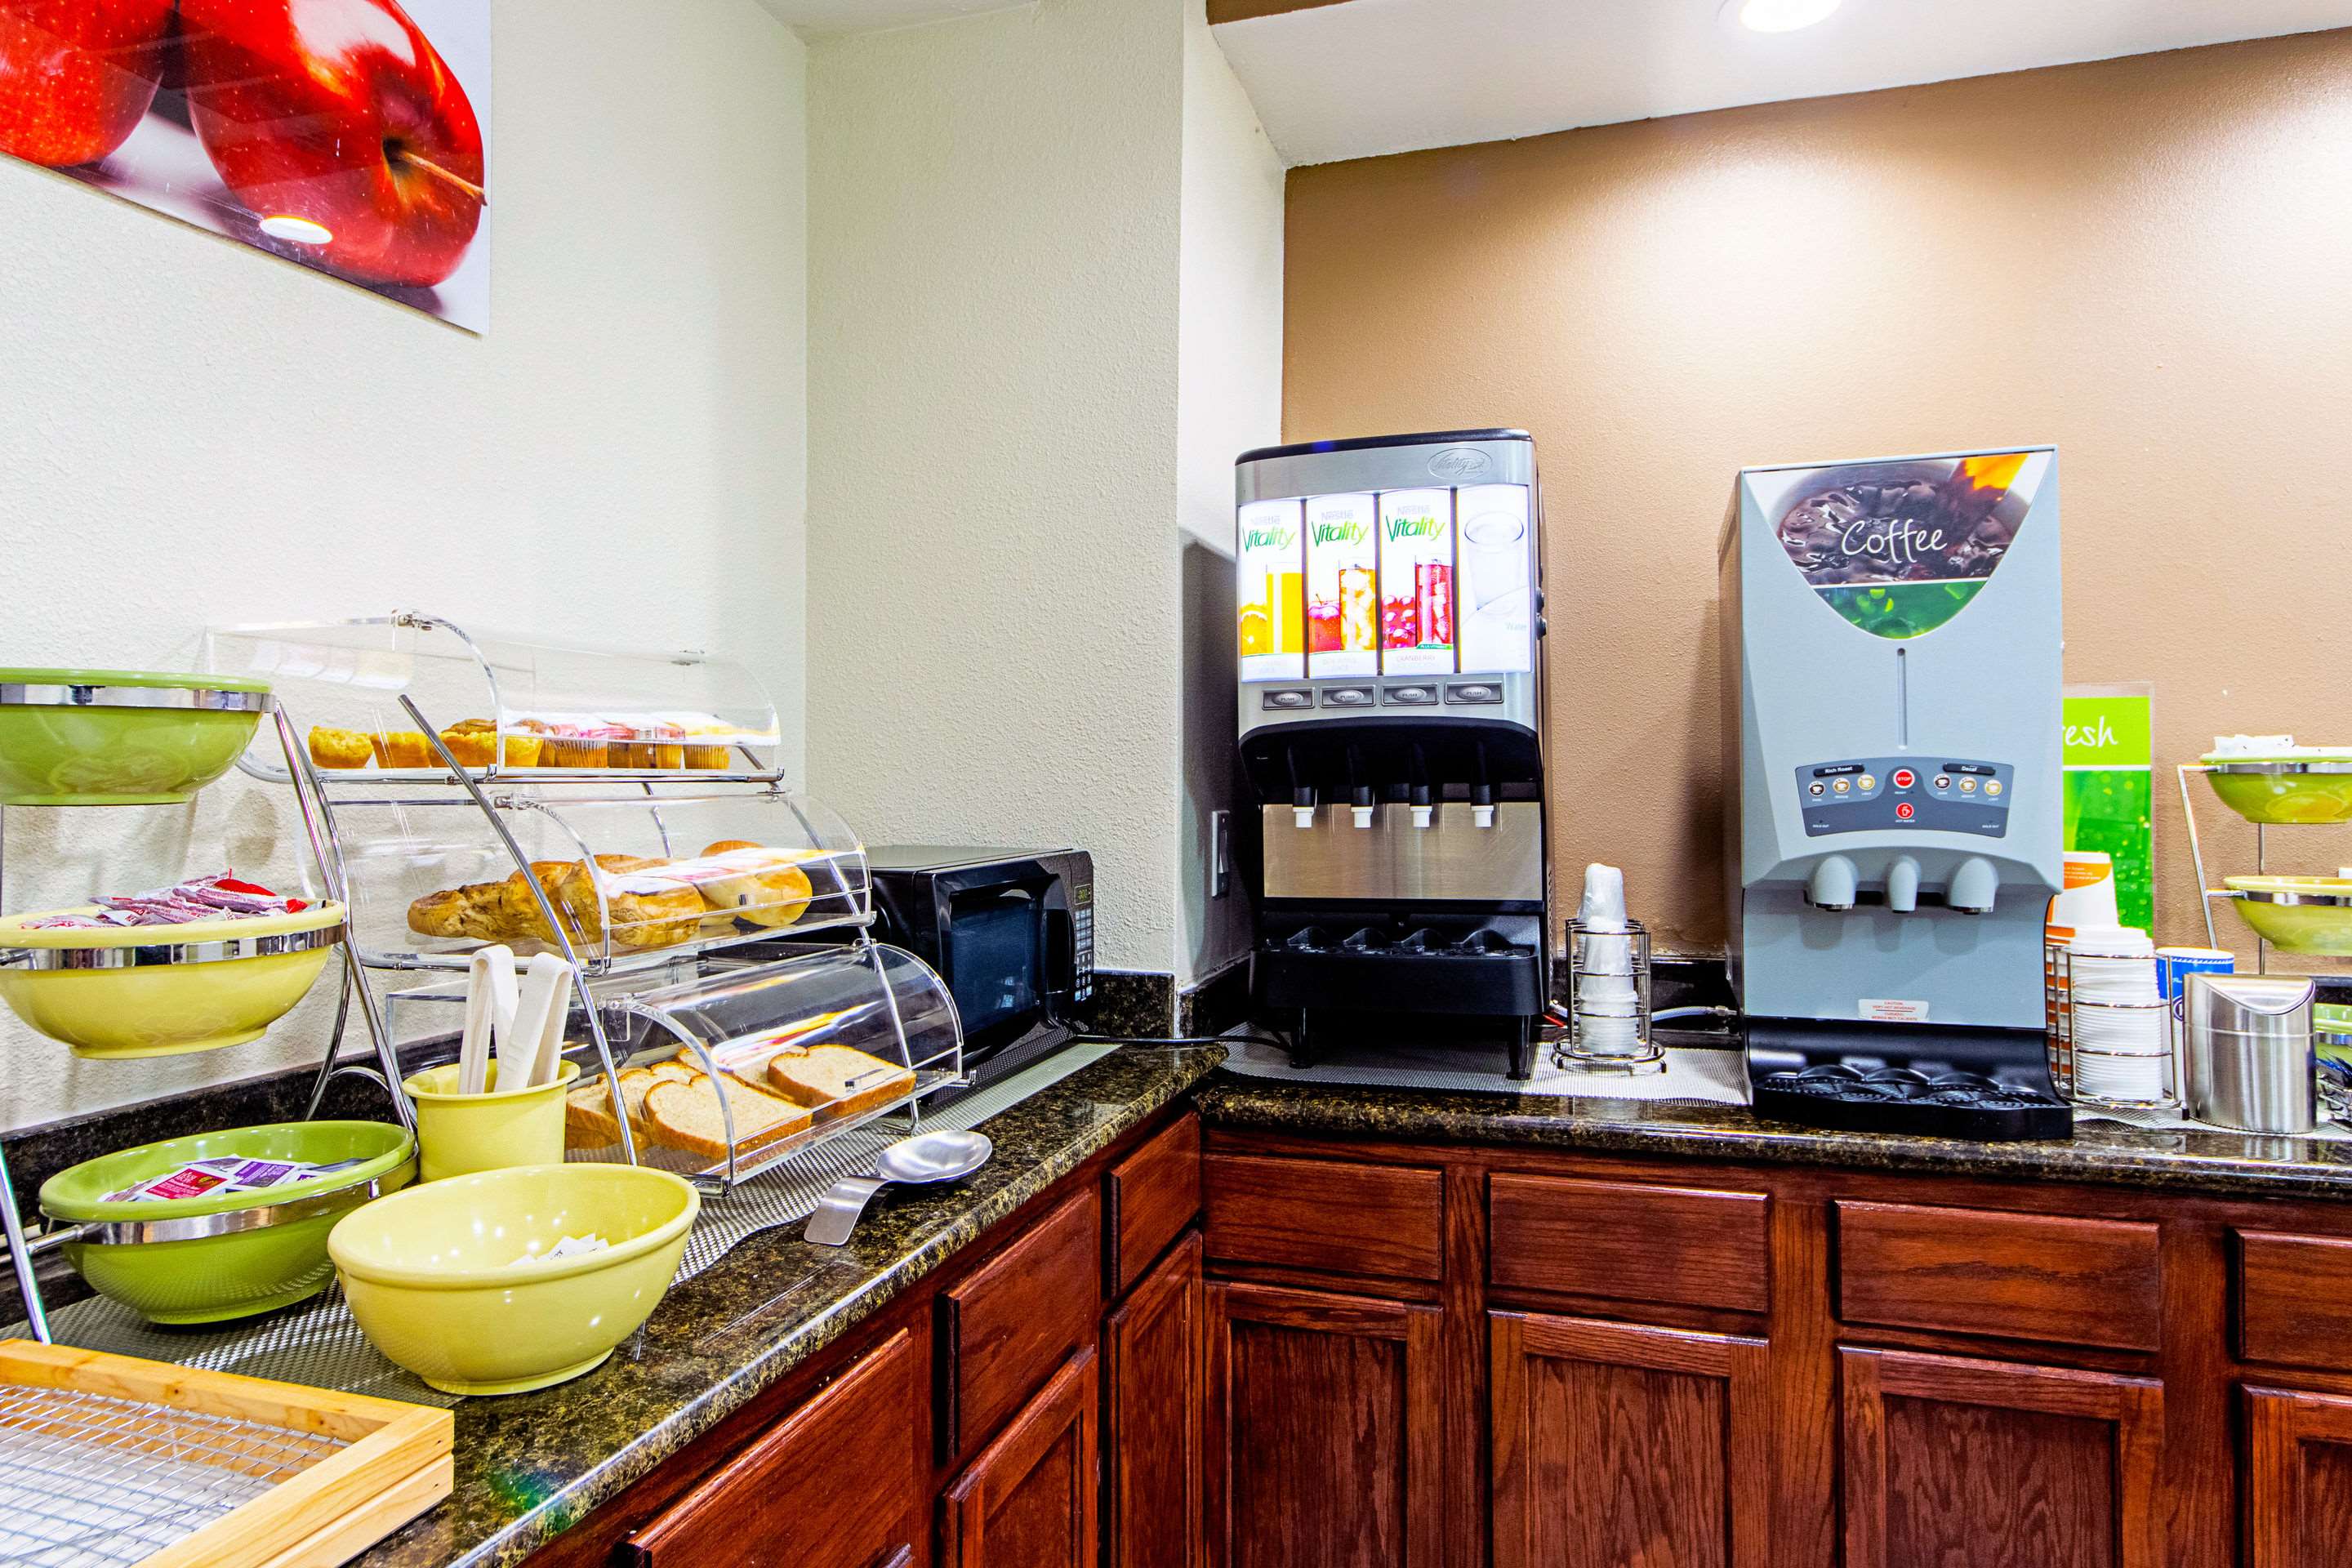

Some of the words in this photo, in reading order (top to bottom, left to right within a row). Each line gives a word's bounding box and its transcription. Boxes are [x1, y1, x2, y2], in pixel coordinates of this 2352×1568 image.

[1242, 525, 1296, 552] Vitality
[1311, 520, 1369, 547] Vitality
[1385, 514, 1446, 542] Vitality
[1841, 519, 1948, 564] Coffee
[2062, 715, 2118, 747] esh
